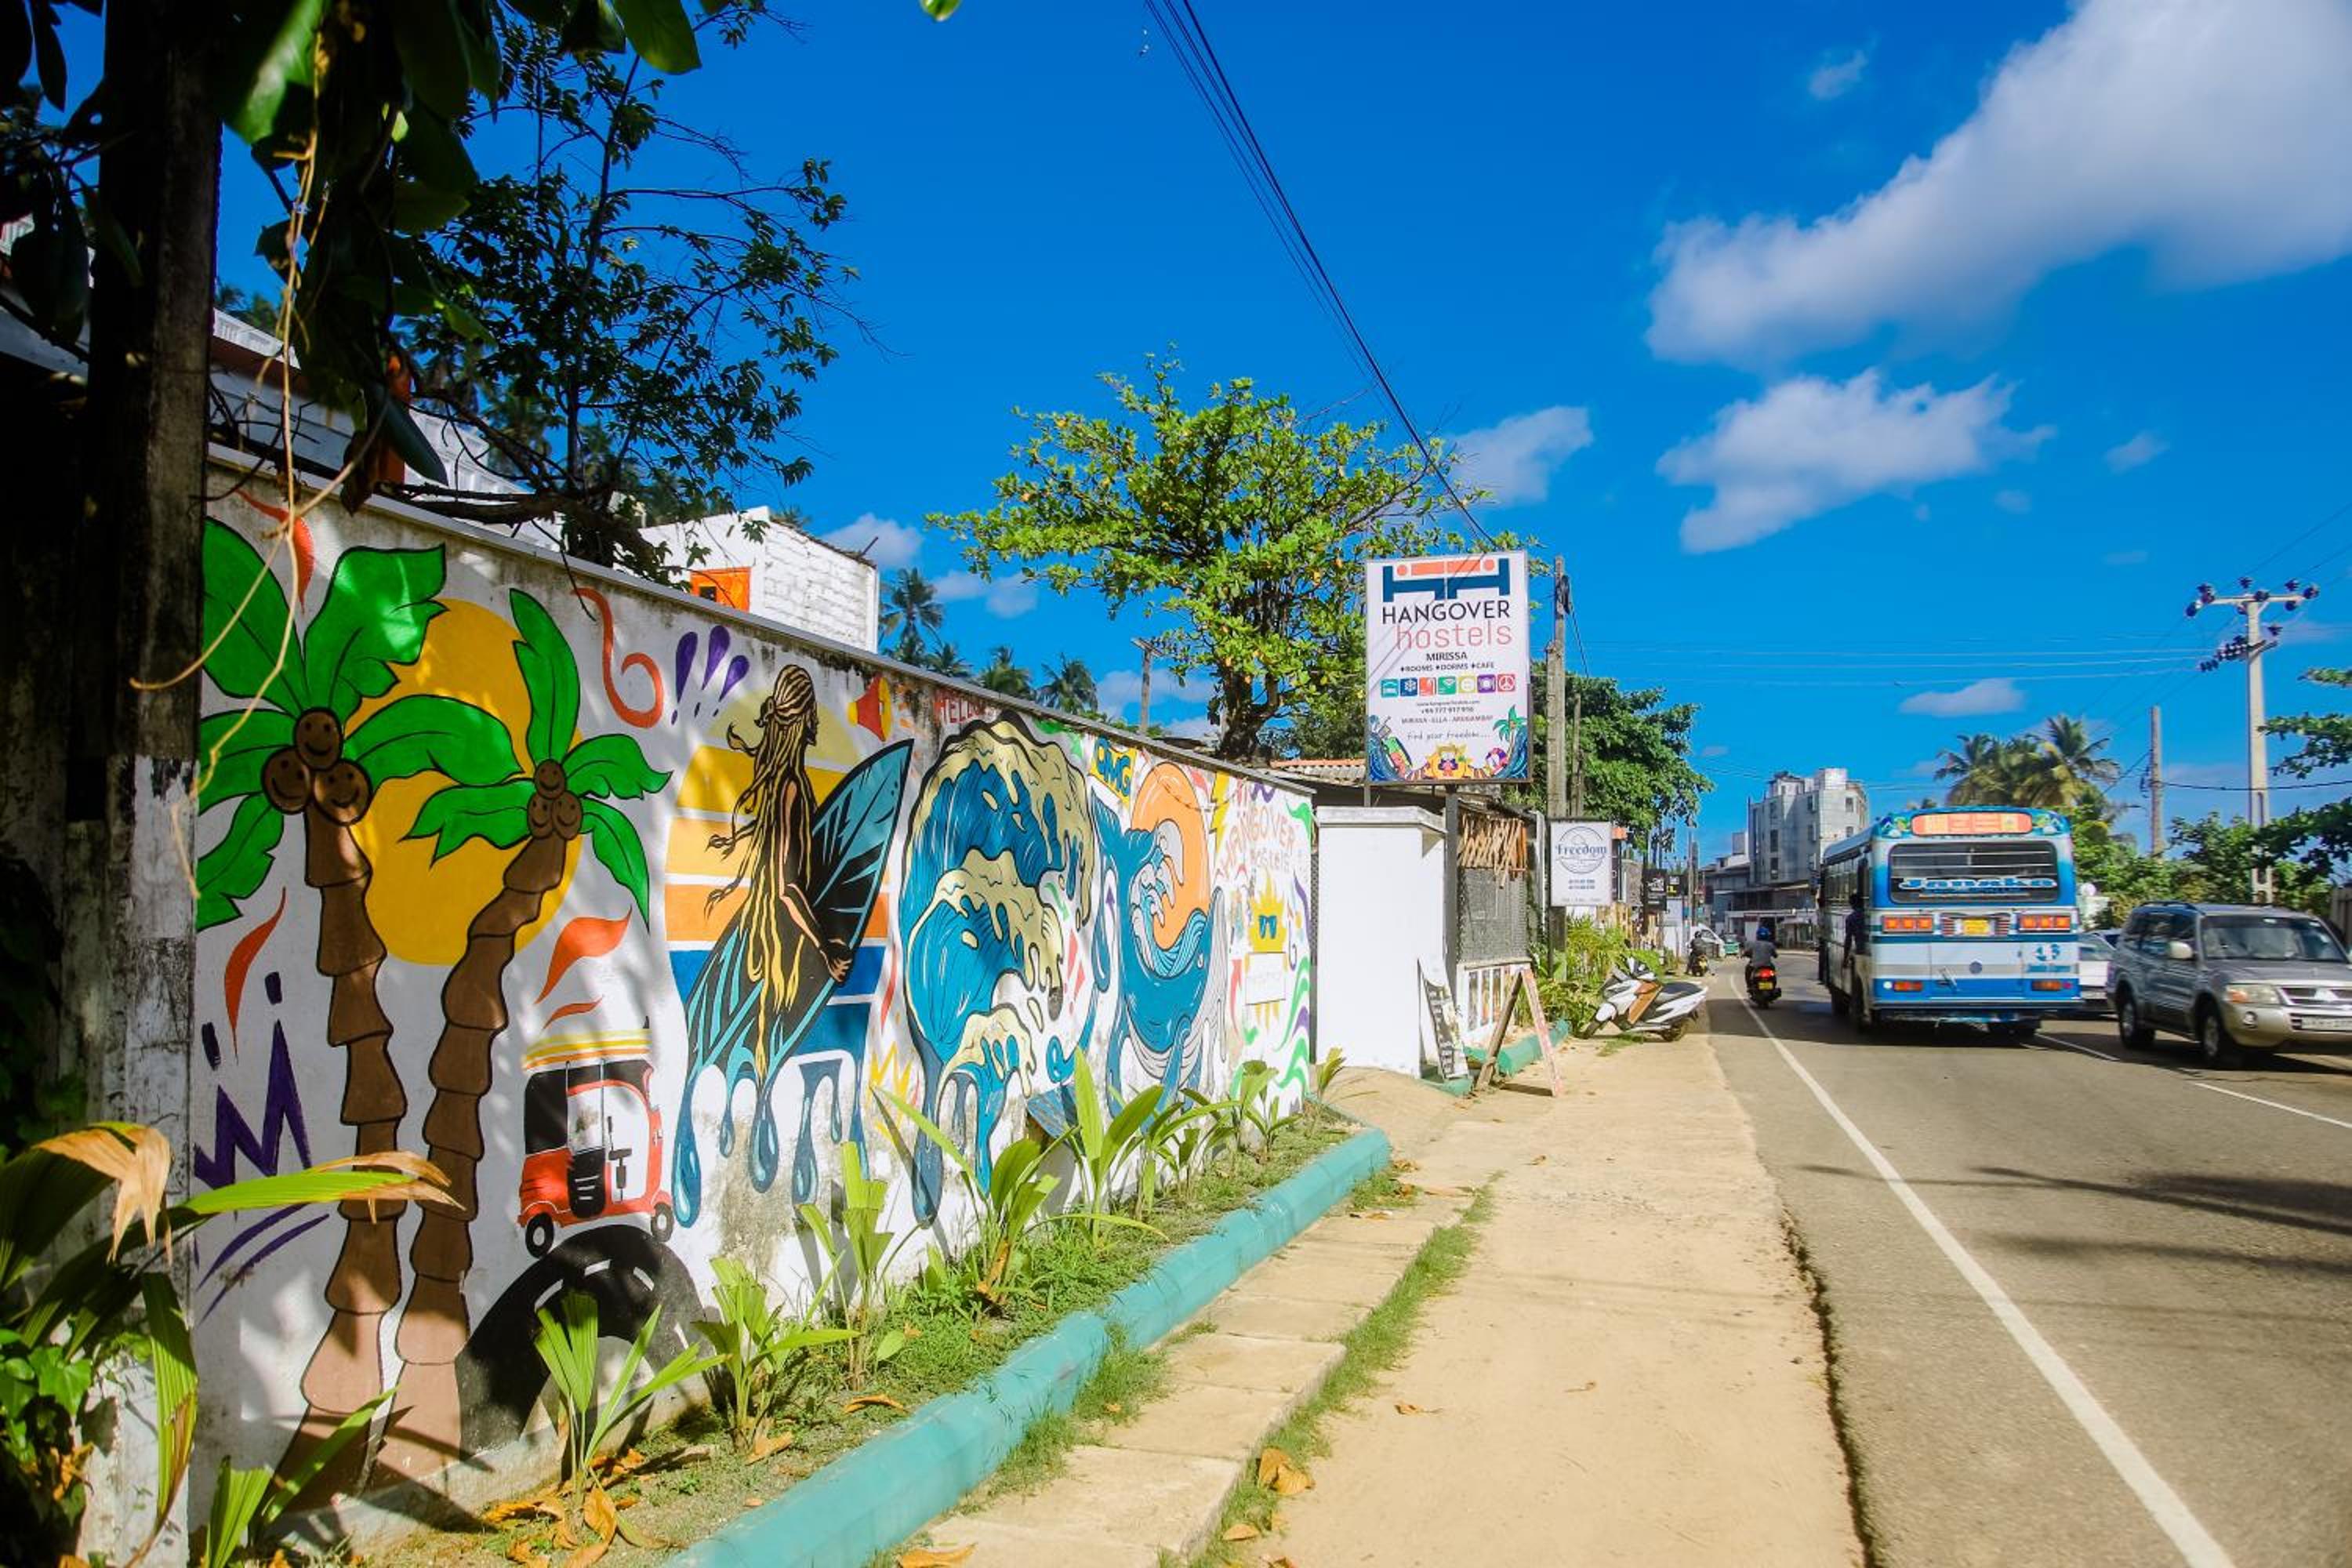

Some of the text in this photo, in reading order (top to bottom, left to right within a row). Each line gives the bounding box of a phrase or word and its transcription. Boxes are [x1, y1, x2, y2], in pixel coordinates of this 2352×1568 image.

[1382, 601, 1510, 624] HANGOVER
[1396, 620, 1512, 649] hostels
[1426, 652, 1468, 661] MIRISSA
[1098, 735, 1131, 797] OMG
